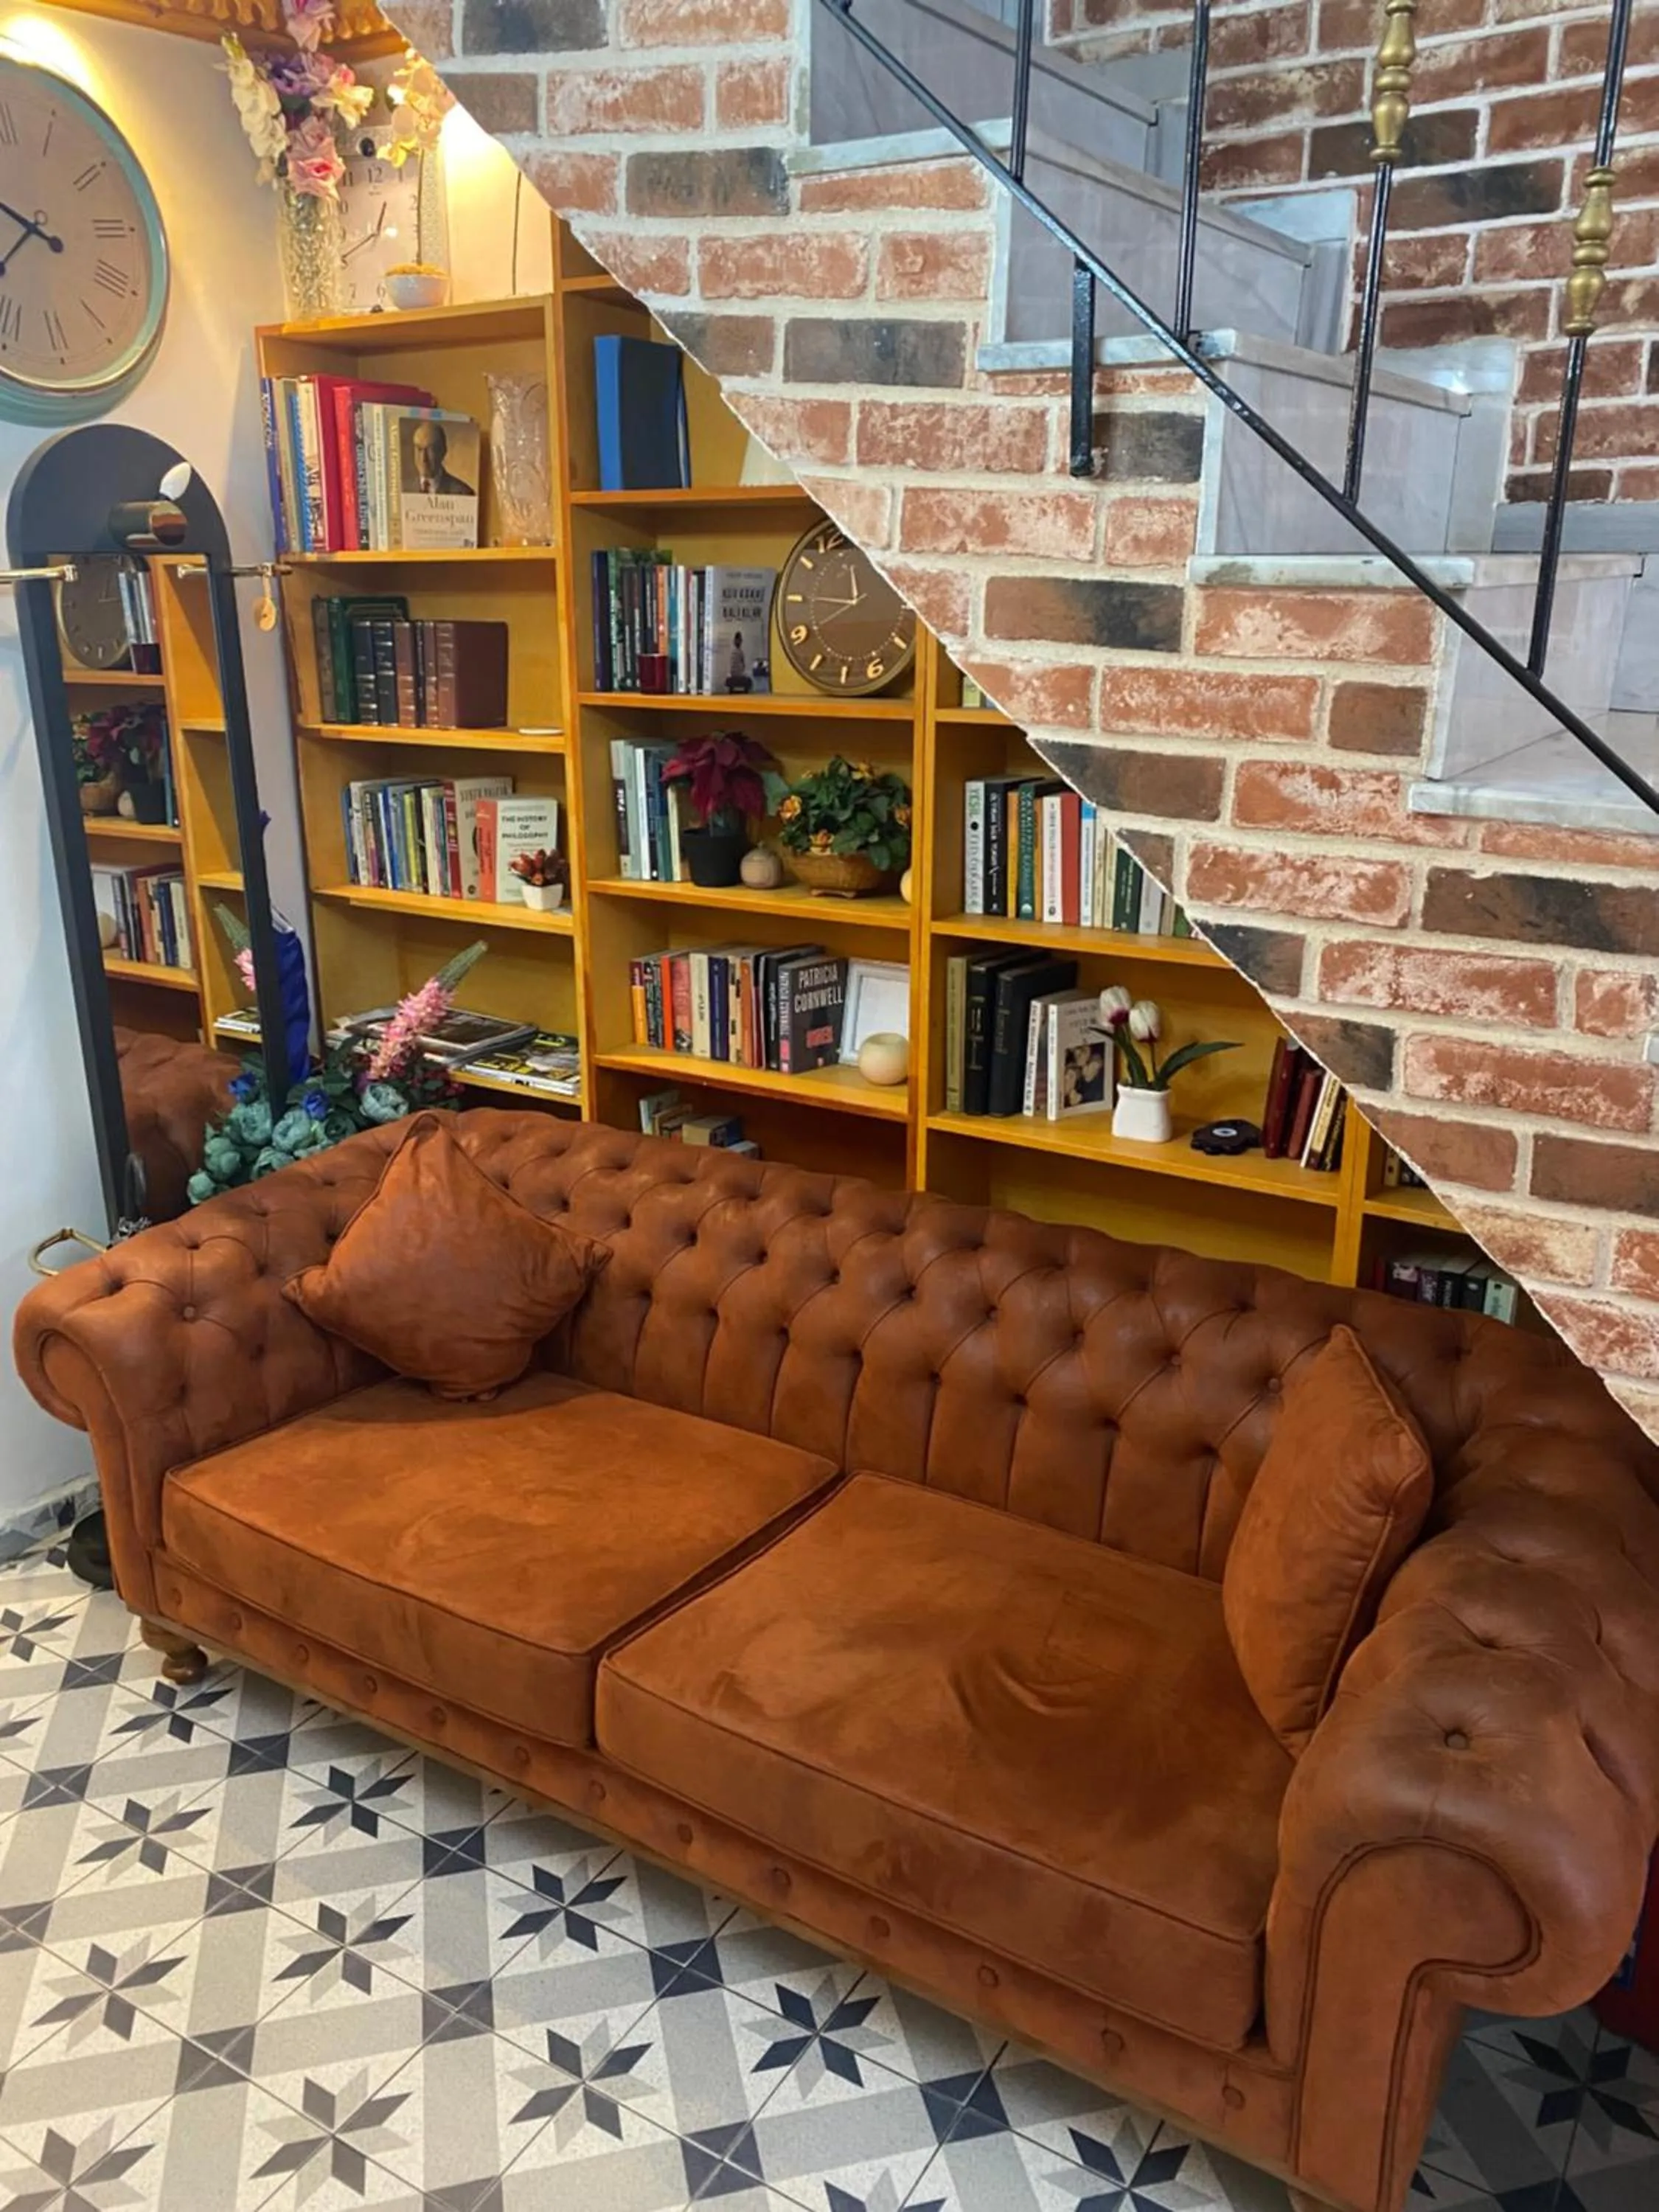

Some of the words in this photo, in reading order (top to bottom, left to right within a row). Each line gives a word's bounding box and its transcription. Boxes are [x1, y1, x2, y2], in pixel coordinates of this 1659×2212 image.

[368, 167, 383, 184] 12
[427, 496, 455, 510] Alan
[405, 508, 475, 528] Greenspan
[790, 625, 808, 646] 9
[866, 658, 884, 679] 6
[799, 963, 838, 989] PATRICIA
[794, 985, 844, 1013] CORNWELL
